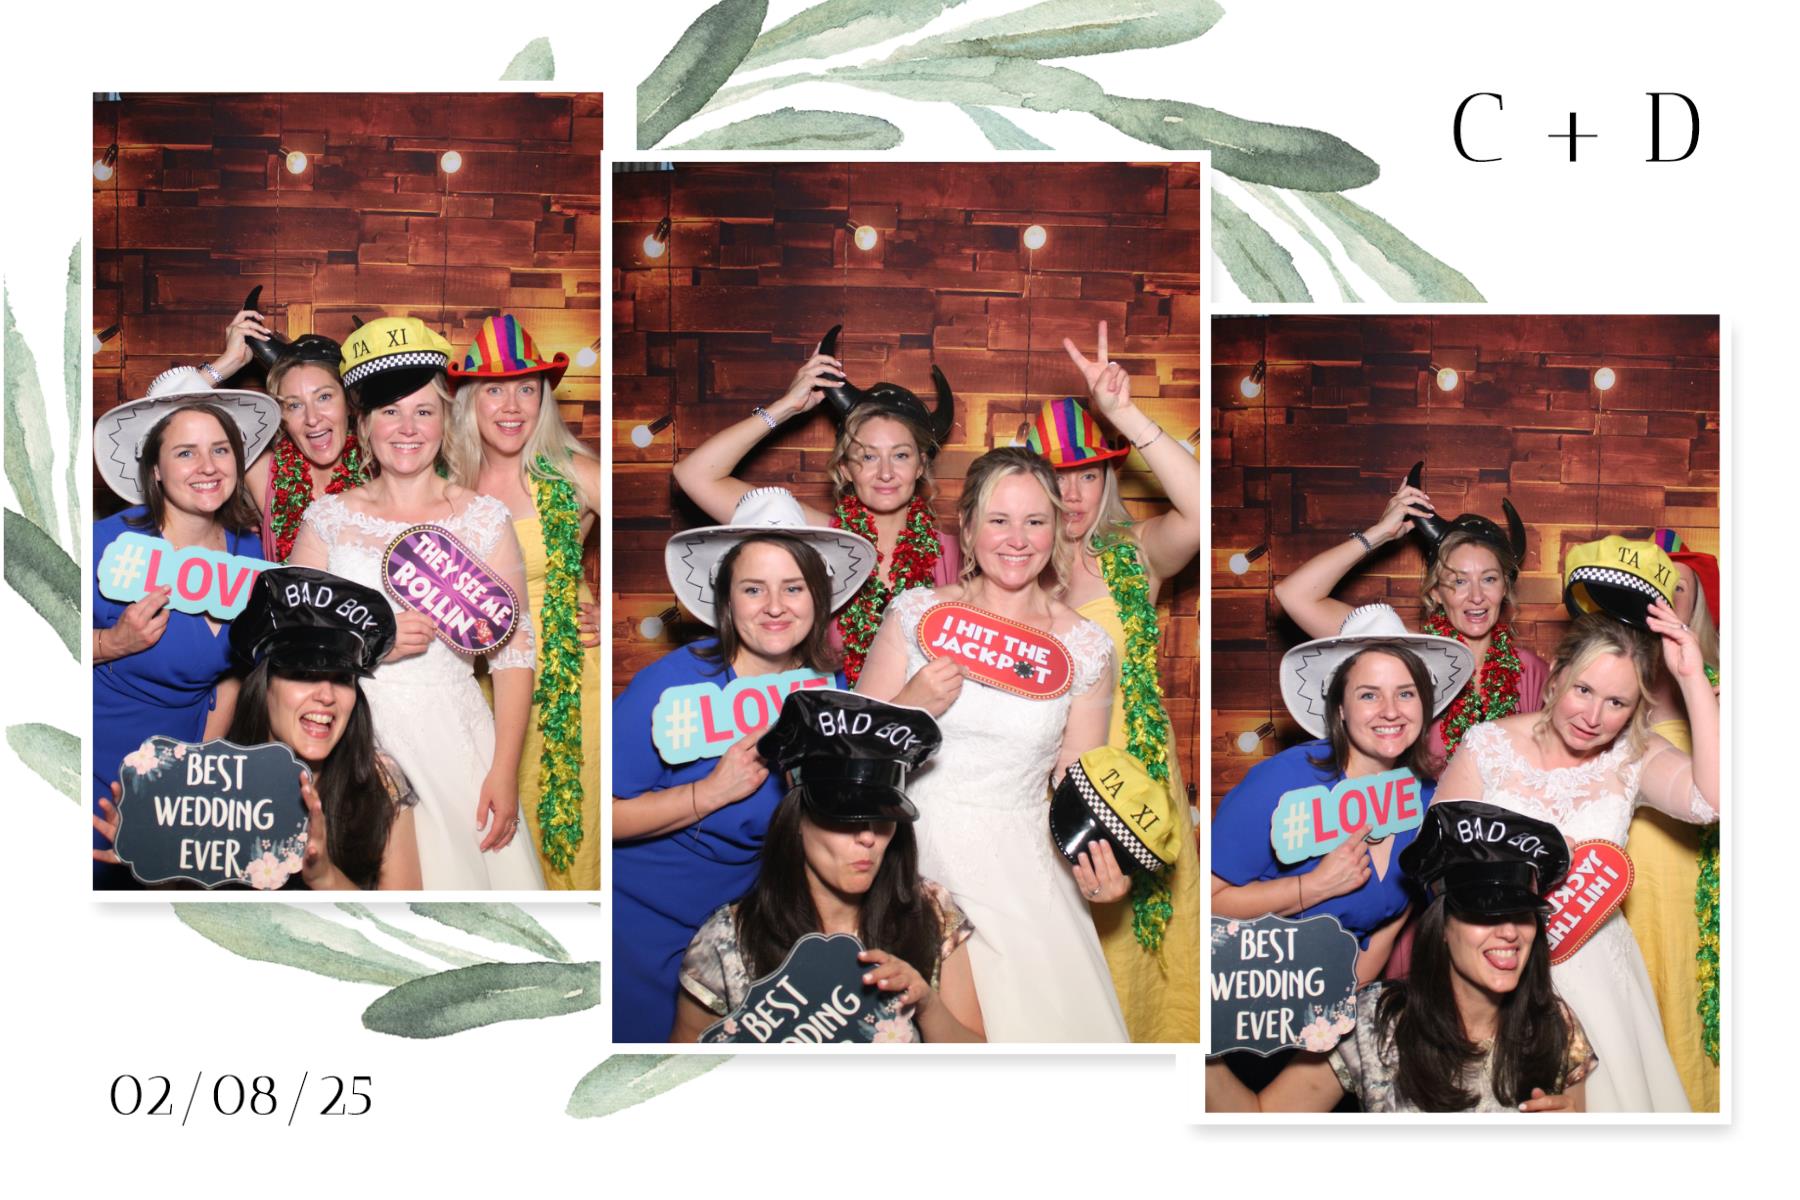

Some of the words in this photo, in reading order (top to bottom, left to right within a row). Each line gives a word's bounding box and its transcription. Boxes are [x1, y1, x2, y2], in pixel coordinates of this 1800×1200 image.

[110, 543, 263, 608] #LOV
[285, 582, 333, 608] BAD
[413, 533, 459, 579] THEY
[452, 571, 488, 605] SEE
[479, 596, 512, 626] ME
[392, 560, 477, 637] ROLLIN
[942, 615, 954, 632] I
[956, 619, 999, 645] HIT
[1003, 635, 1051, 666] THE
[818, 709, 872, 736] BAD
[186, 753, 248, 792] BEST
[154, 795, 275, 832] WEDDING
[1282, 776, 1418, 851] #LOVE
[1457, 817, 1506, 844] BAD
[179, 838, 245, 878] EVER
[1602, 865, 1619, 880] I
[1576, 875, 1611, 914] HIT
[1240, 928, 1299, 964] BEST
[1211, 967, 1326, 1001] WEDDING
[740, 975, 809, 1043] BEST
[780, 984, 861, 1043] DING
[1236, 1007, 1300, 1045] EVER
